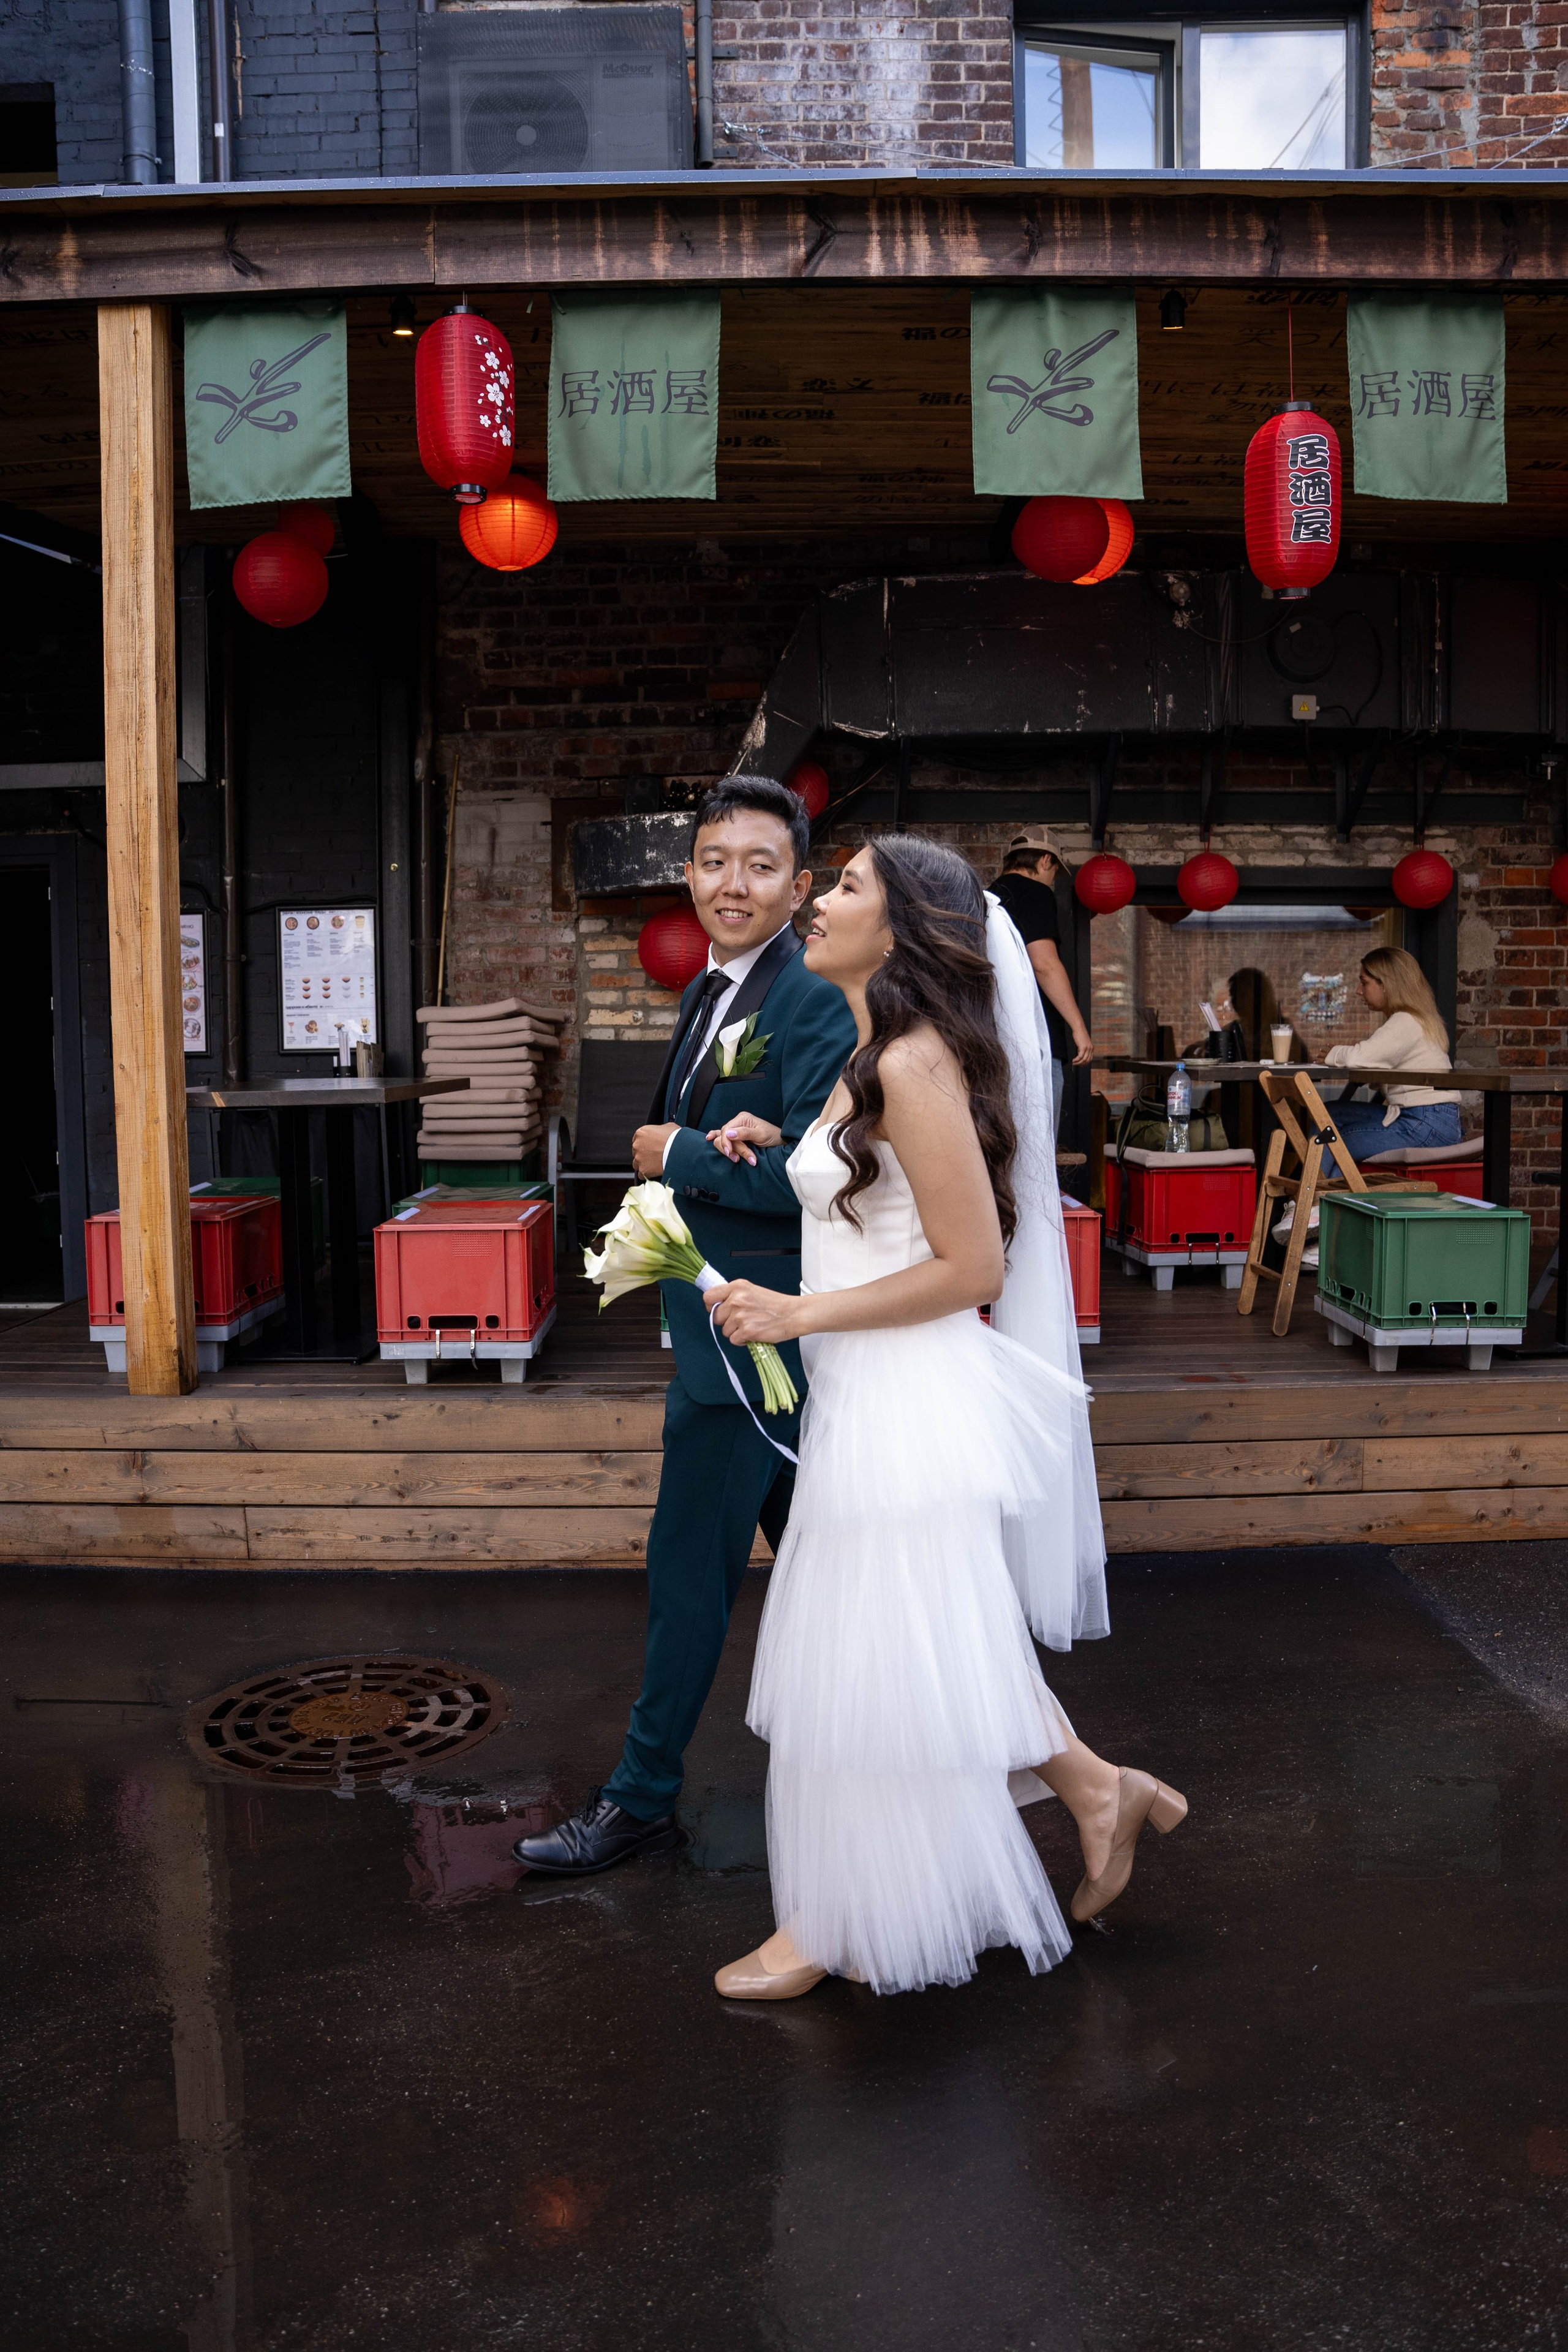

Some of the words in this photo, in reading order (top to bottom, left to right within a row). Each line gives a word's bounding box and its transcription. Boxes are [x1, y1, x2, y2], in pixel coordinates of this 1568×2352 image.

[602, 63, 653, 74] McQuay
[557, 369, 709, 418] 居酒屋
[1357, 370, 1496, 420] 居酒屋
[1287, 434, 1332, 544] 居酒屋
